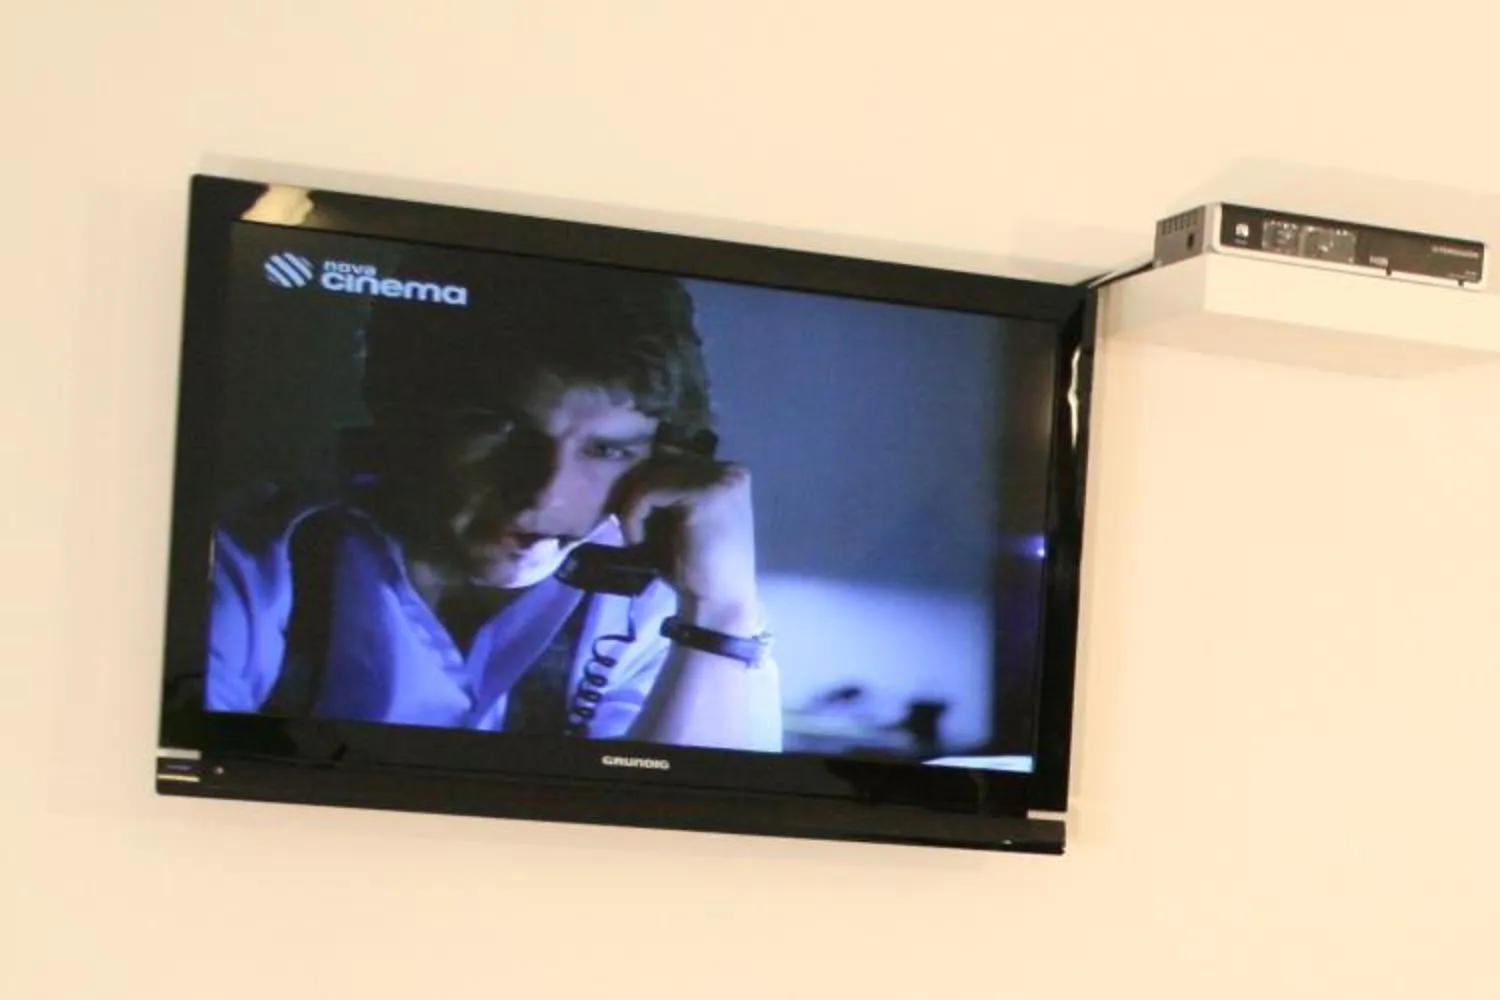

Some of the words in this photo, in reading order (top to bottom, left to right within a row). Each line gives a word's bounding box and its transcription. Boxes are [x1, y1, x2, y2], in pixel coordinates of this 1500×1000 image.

[323, 260, 377, 276] nova
[320, 271, 468, 305] cinema
[601, 755, 671, 770] GRUNDIG
